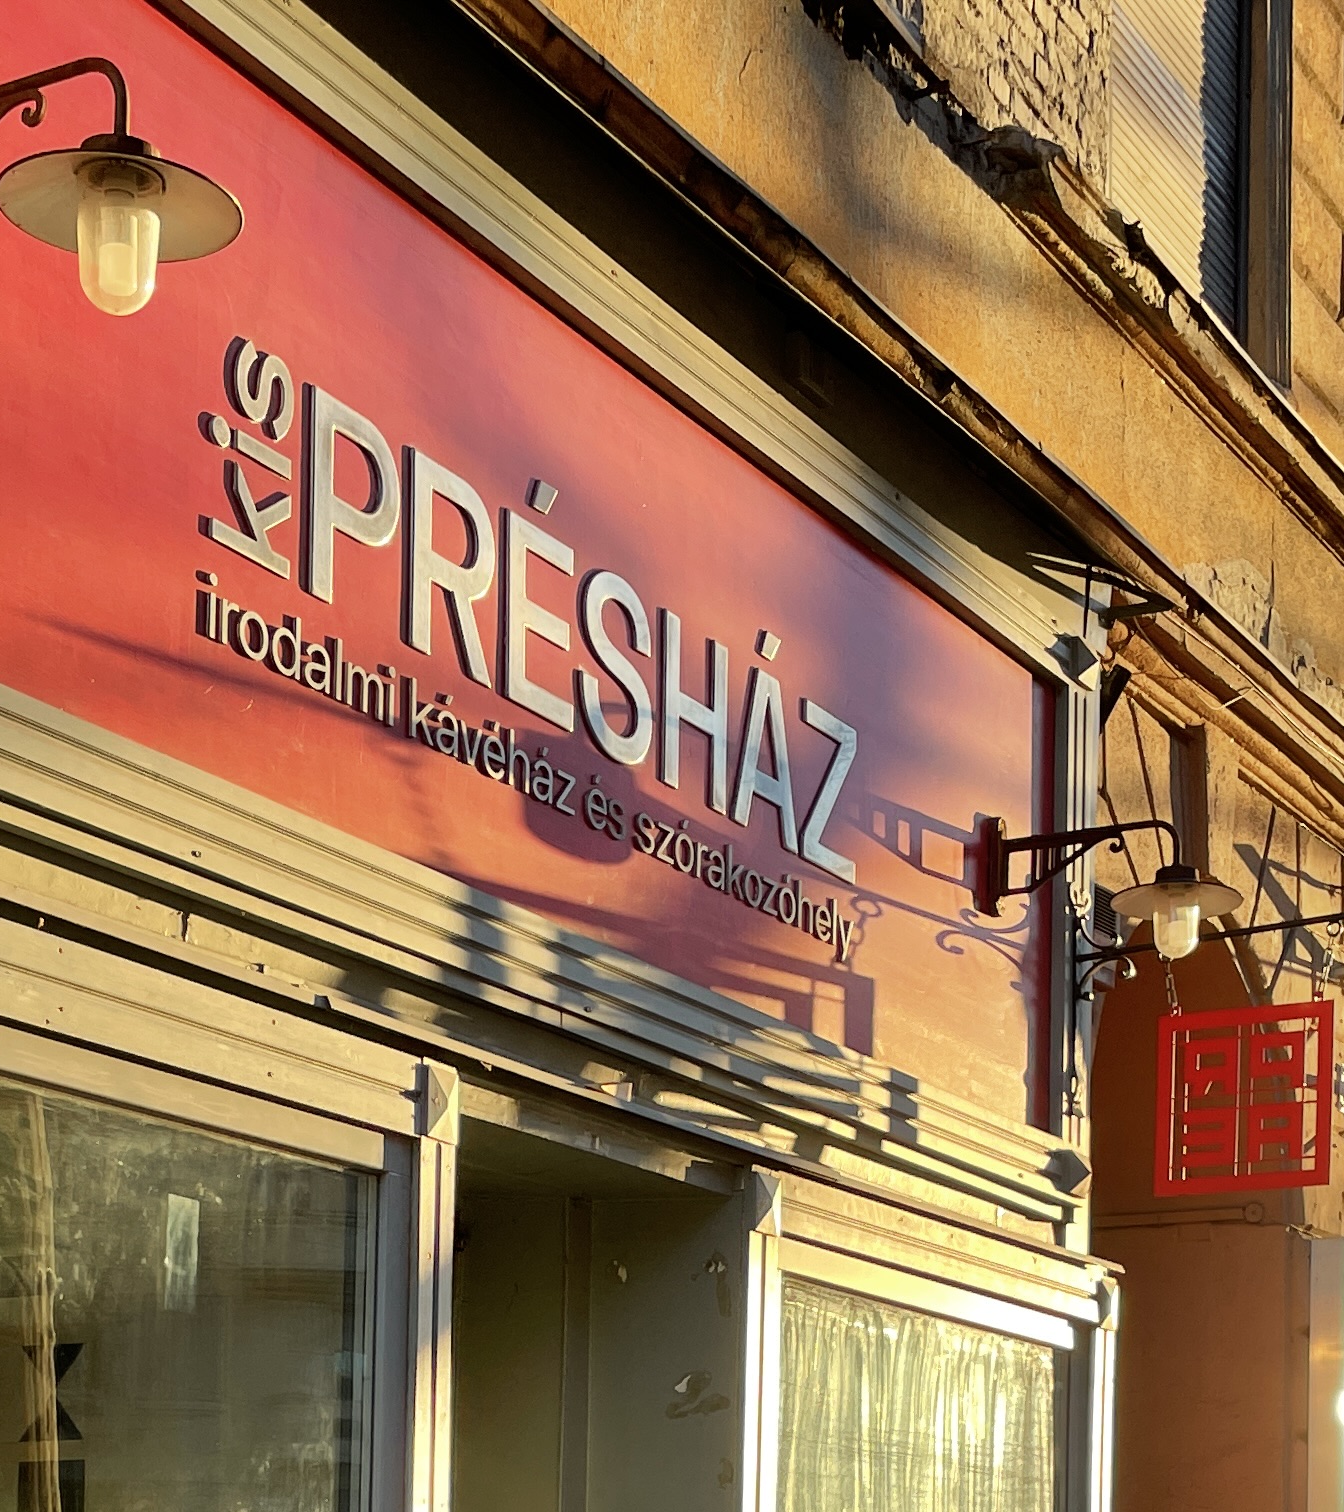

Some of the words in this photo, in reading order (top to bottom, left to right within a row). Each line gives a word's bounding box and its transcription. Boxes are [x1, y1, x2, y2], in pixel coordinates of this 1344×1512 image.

[200, 572, 396, 727] irodalmi
[405, 676, 577, 816] kávéház
[586, 773, 627, 841] és
[635, 813, 855, 962] szórakozóhely
[202, 336, 295, 580] kis
[304, 384, 858, 884] PRÉSHÁZ
